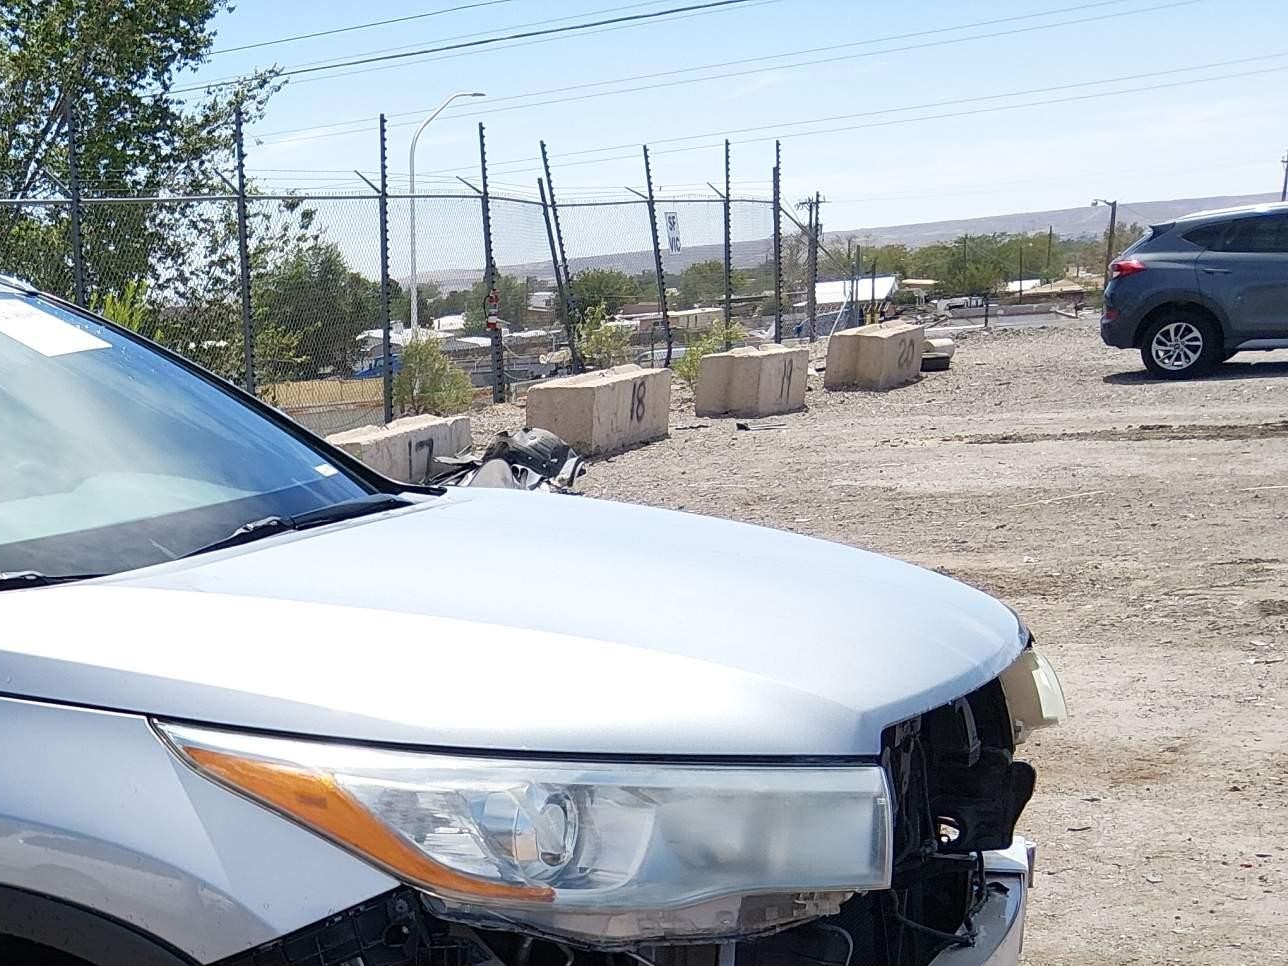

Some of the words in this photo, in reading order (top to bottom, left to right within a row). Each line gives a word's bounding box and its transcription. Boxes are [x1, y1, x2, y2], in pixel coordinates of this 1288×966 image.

[897, 338, 915, 369] 20
[630, 380, 647, 423] 18
[779, 358, 794, 404] 19
[408, 437, 434, 484] 17
